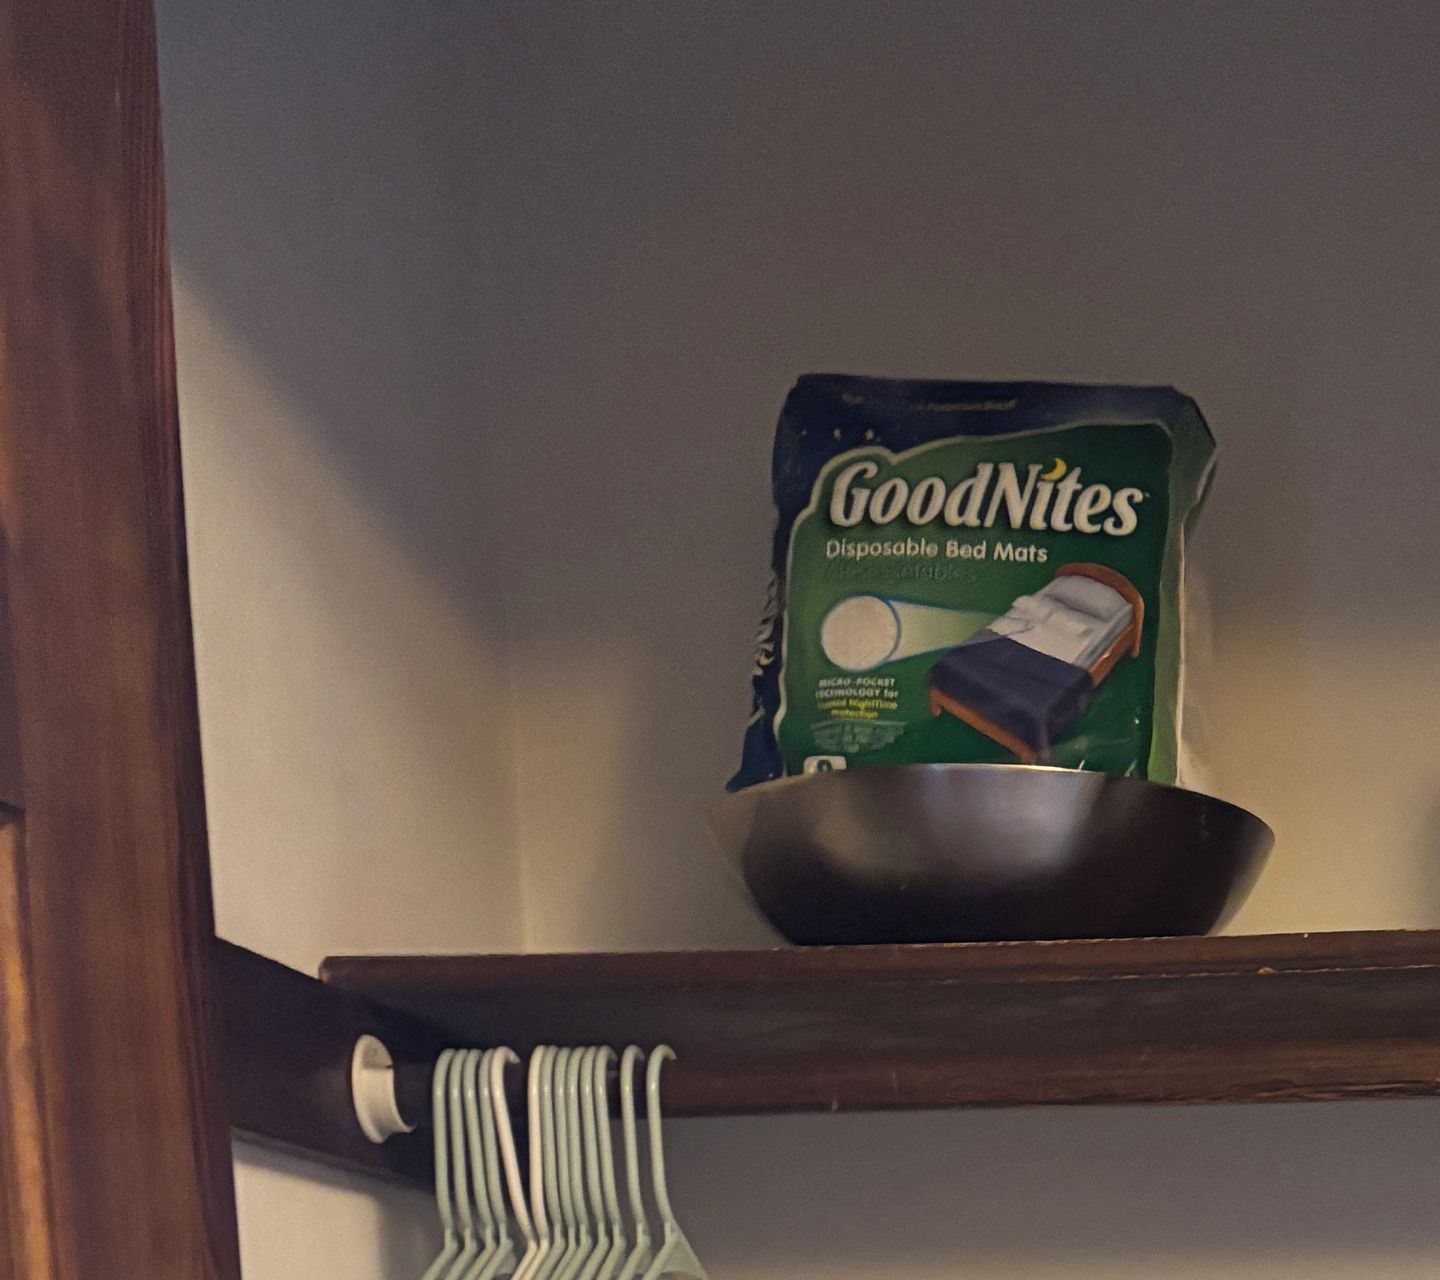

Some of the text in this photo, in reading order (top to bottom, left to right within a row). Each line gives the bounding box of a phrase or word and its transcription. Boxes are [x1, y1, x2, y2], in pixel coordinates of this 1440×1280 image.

[828, 457, 1144, 536] GoodNites
[826, 537, 1048, 563] Disposable Bed Mats
